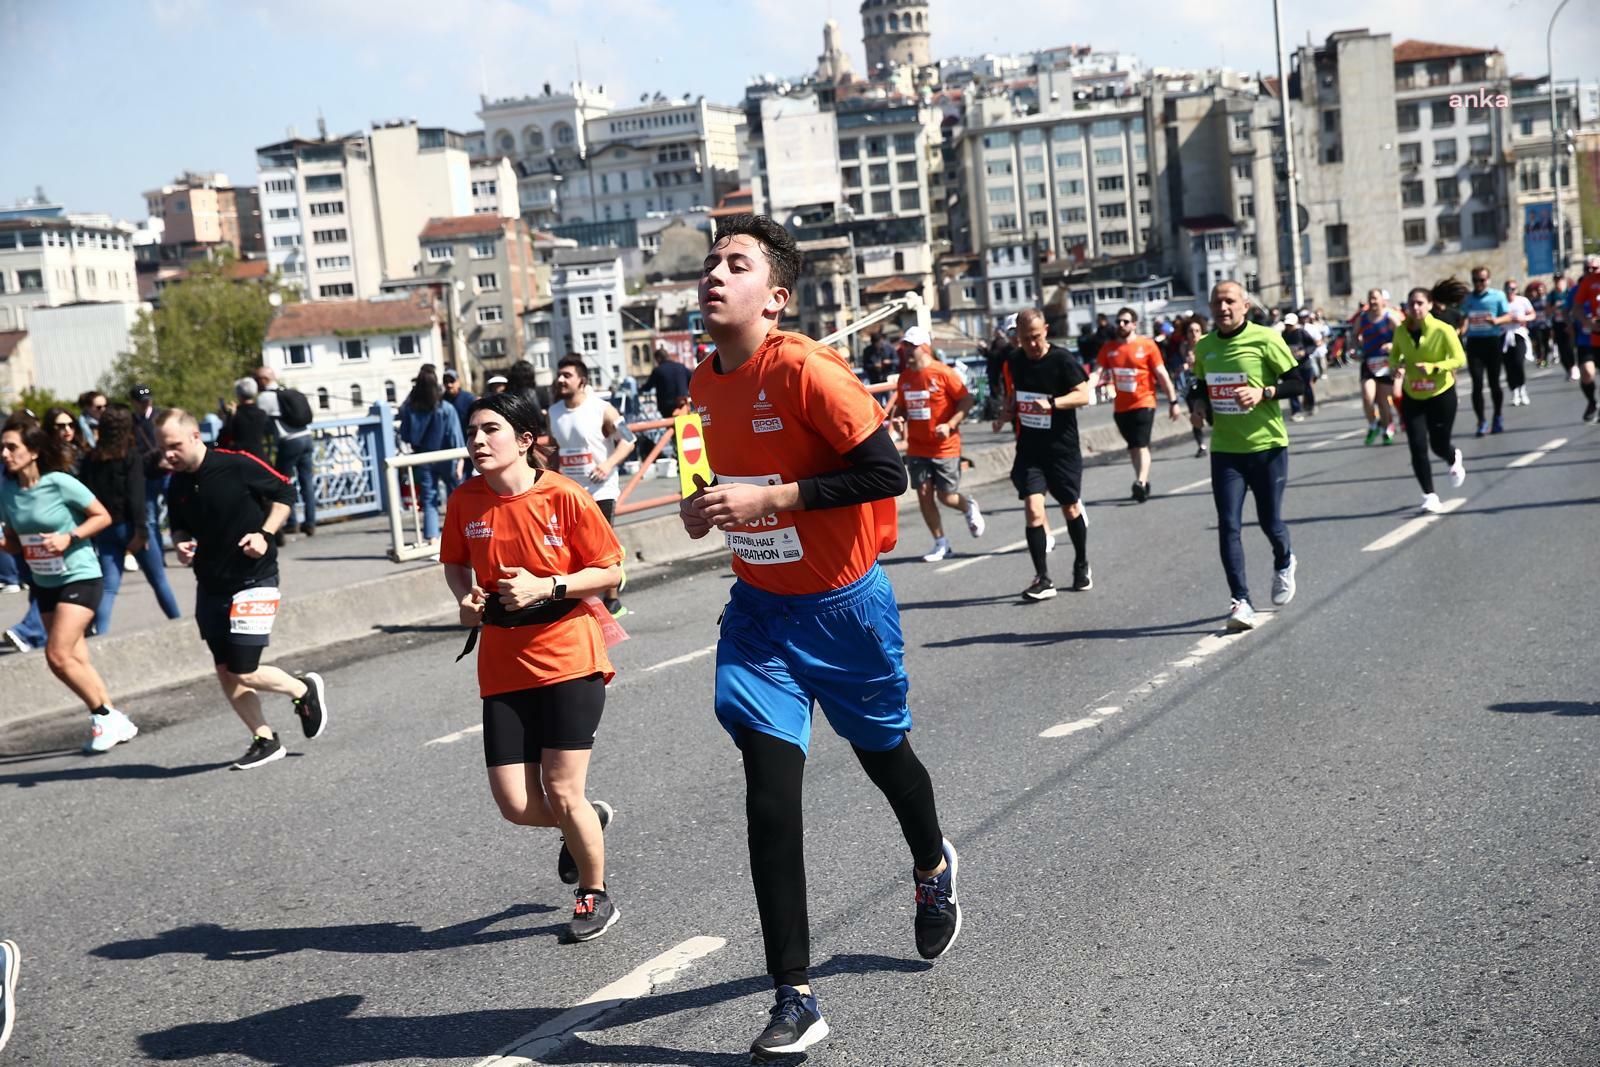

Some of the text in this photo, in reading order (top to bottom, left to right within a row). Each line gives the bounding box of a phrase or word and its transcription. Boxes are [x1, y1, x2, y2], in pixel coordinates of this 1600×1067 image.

[1211, 386, 1236, 397] E 415
[753, 418, 780, 427] SPOR
[756, 537, 776, 547] HALF
[733, 547, 780, 560] MARATHON
[236, 602, 276, 615] C 2566
